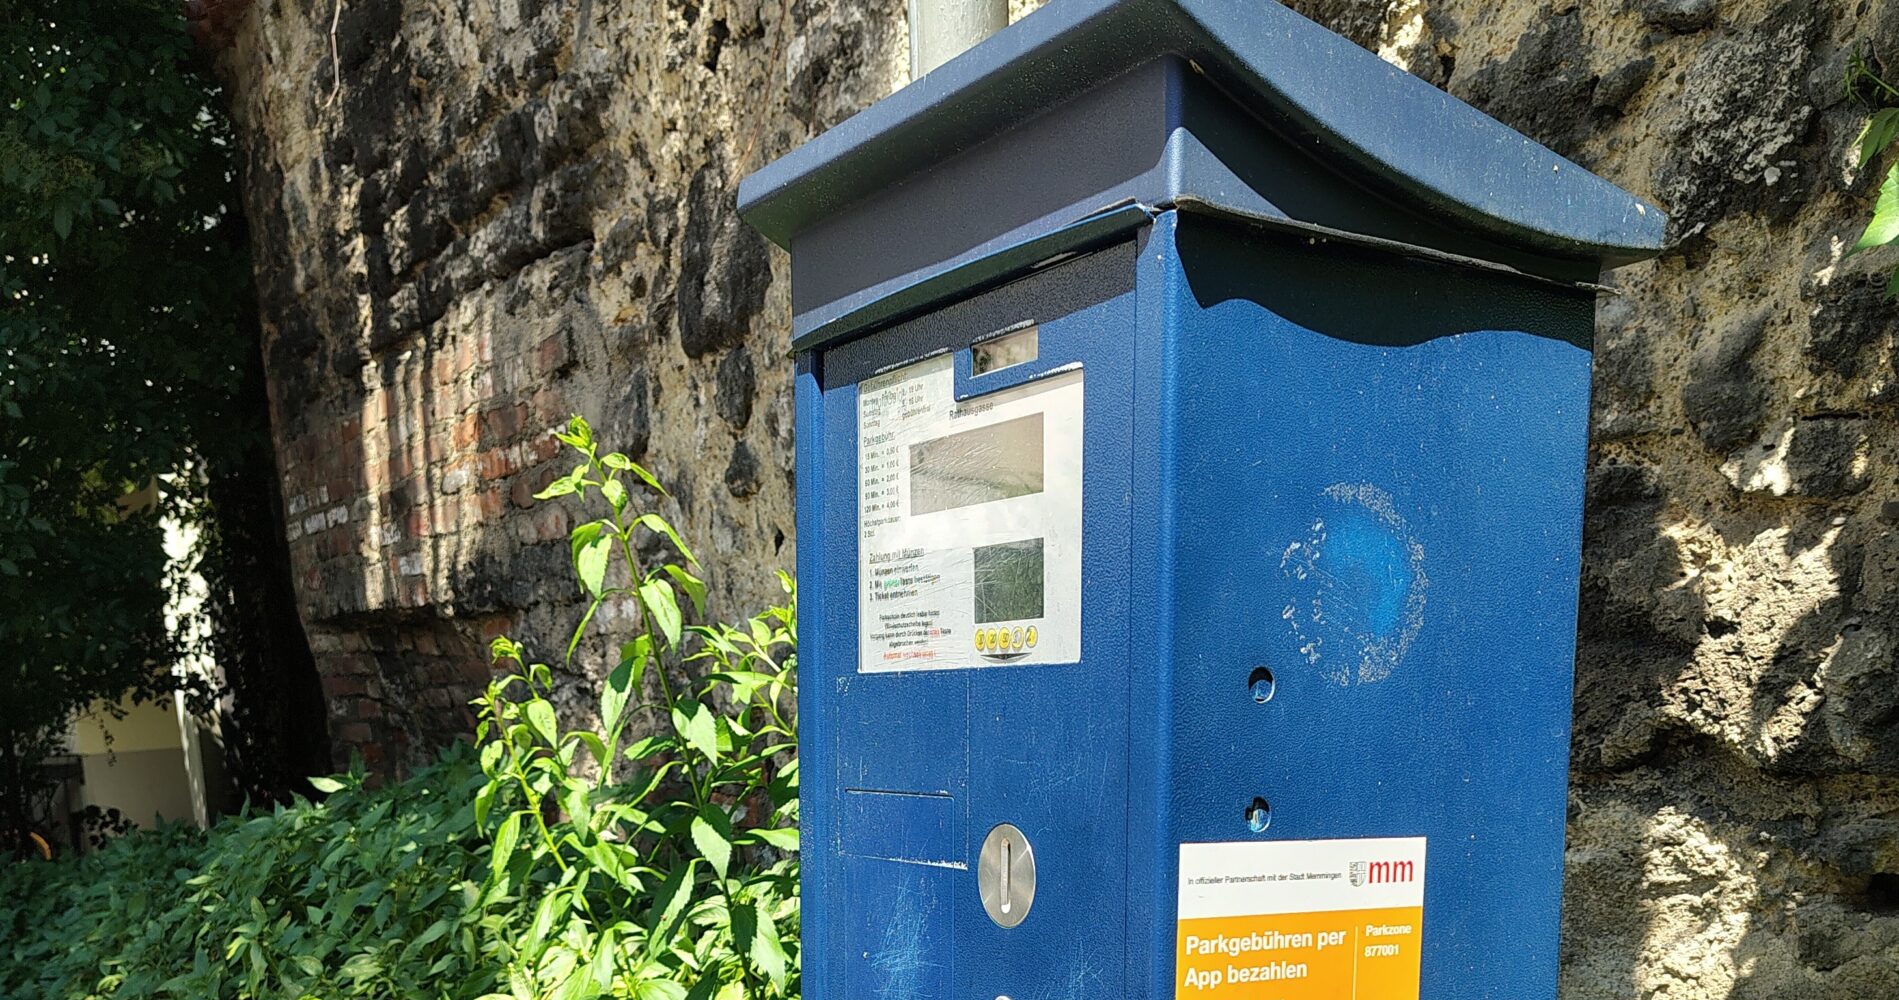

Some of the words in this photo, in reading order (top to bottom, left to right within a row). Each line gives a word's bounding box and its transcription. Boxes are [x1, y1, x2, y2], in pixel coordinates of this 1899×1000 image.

[949, 402, 994, 421] Rathausgasse
[1188, 877, 1194, 886] In
[1196, 876, 1224, 885] offizieller
[1225, 874, 1266, 884] Partnerschaft
[1267, 874, 1277, 882] mit
[1289, 872, 1305, 880] Stadt
[1306, 872, 1342, 881] Memmingen
[1368, 859, 1414, 884] mm
[1365, 923, 1412, 937] Parkzone
[1185, 929, 1313, 957] Parkgebühren
[1317, 929, 1347, 951] per
[1364, 944, 1400, 958] 877001
[1184, 966, 1223, 991] App
[1227, 960, 1308, 985] bezahlen
